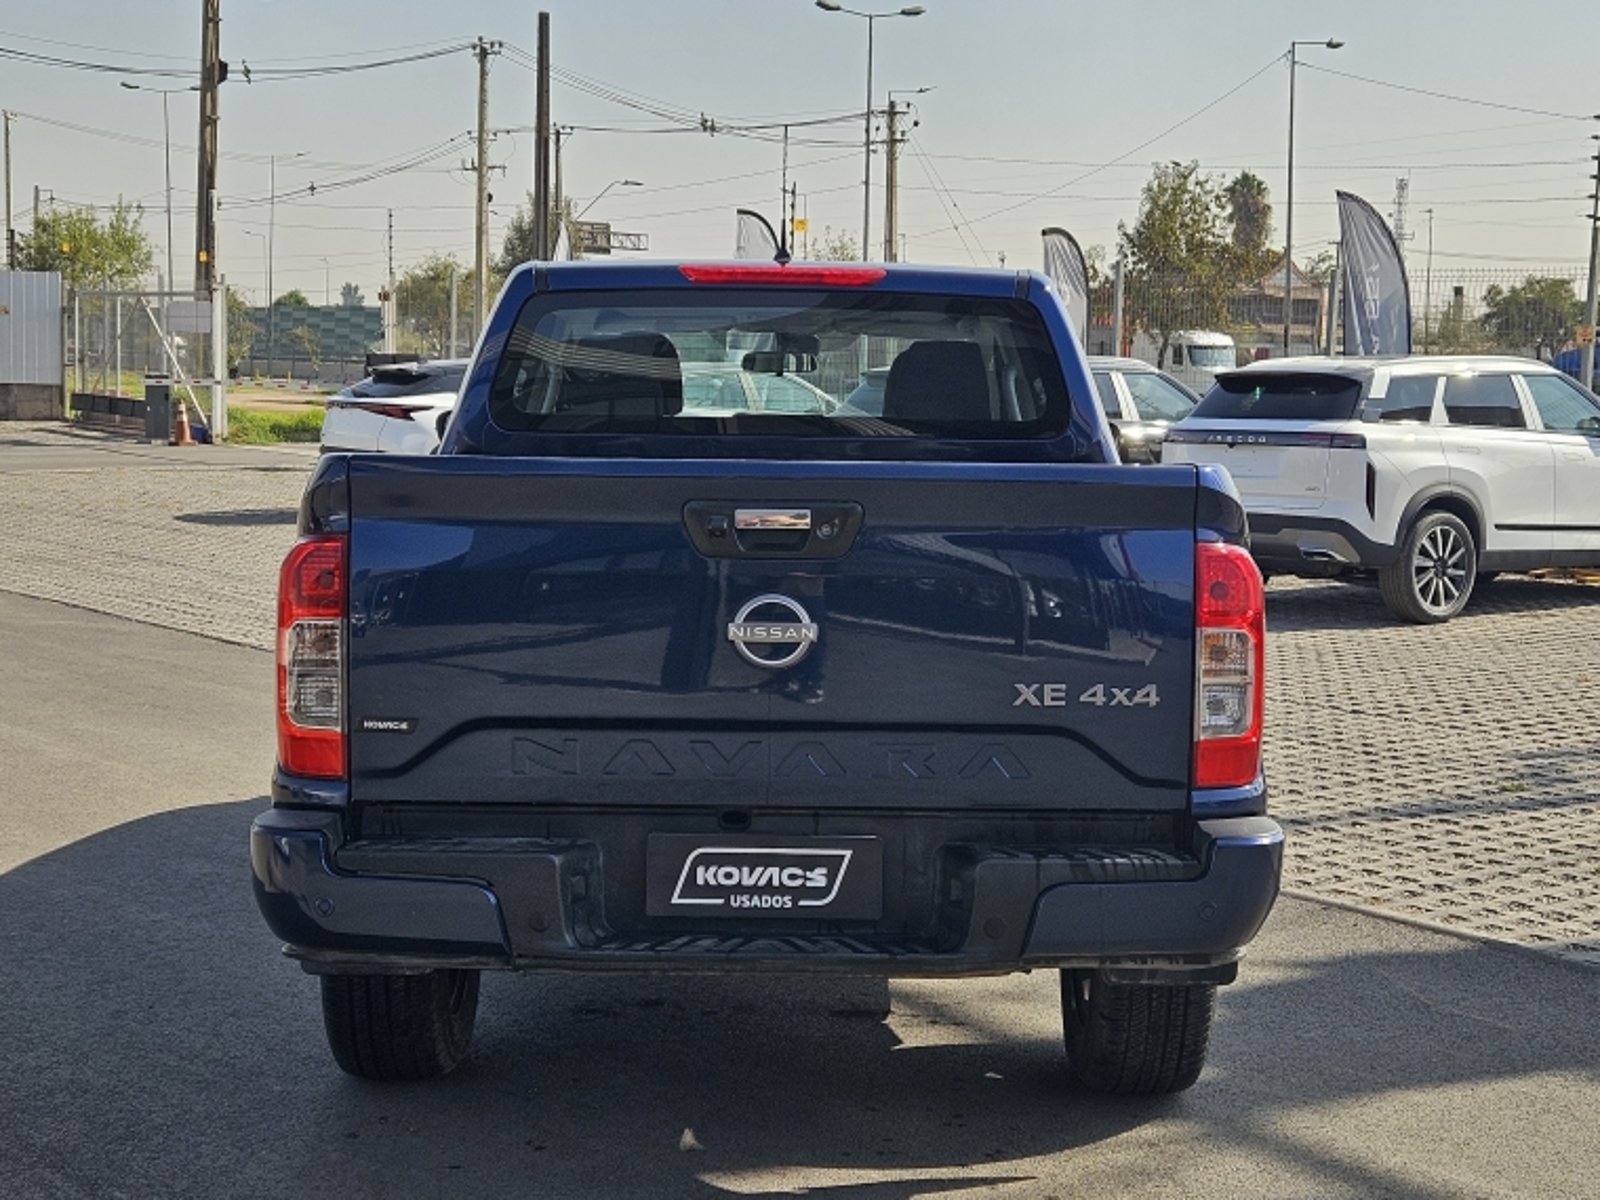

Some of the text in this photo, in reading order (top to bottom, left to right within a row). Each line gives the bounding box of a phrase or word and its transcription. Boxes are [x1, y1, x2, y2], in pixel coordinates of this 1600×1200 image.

[730, 626, 814, 640] NISSAN
[1012, 683, 1161, 707] XE 4x4
[511, 736, 1032, 779] NAVARA
[696, 865, 829, 887] KOVACS
[729, 894, 793, 908] USADOS
